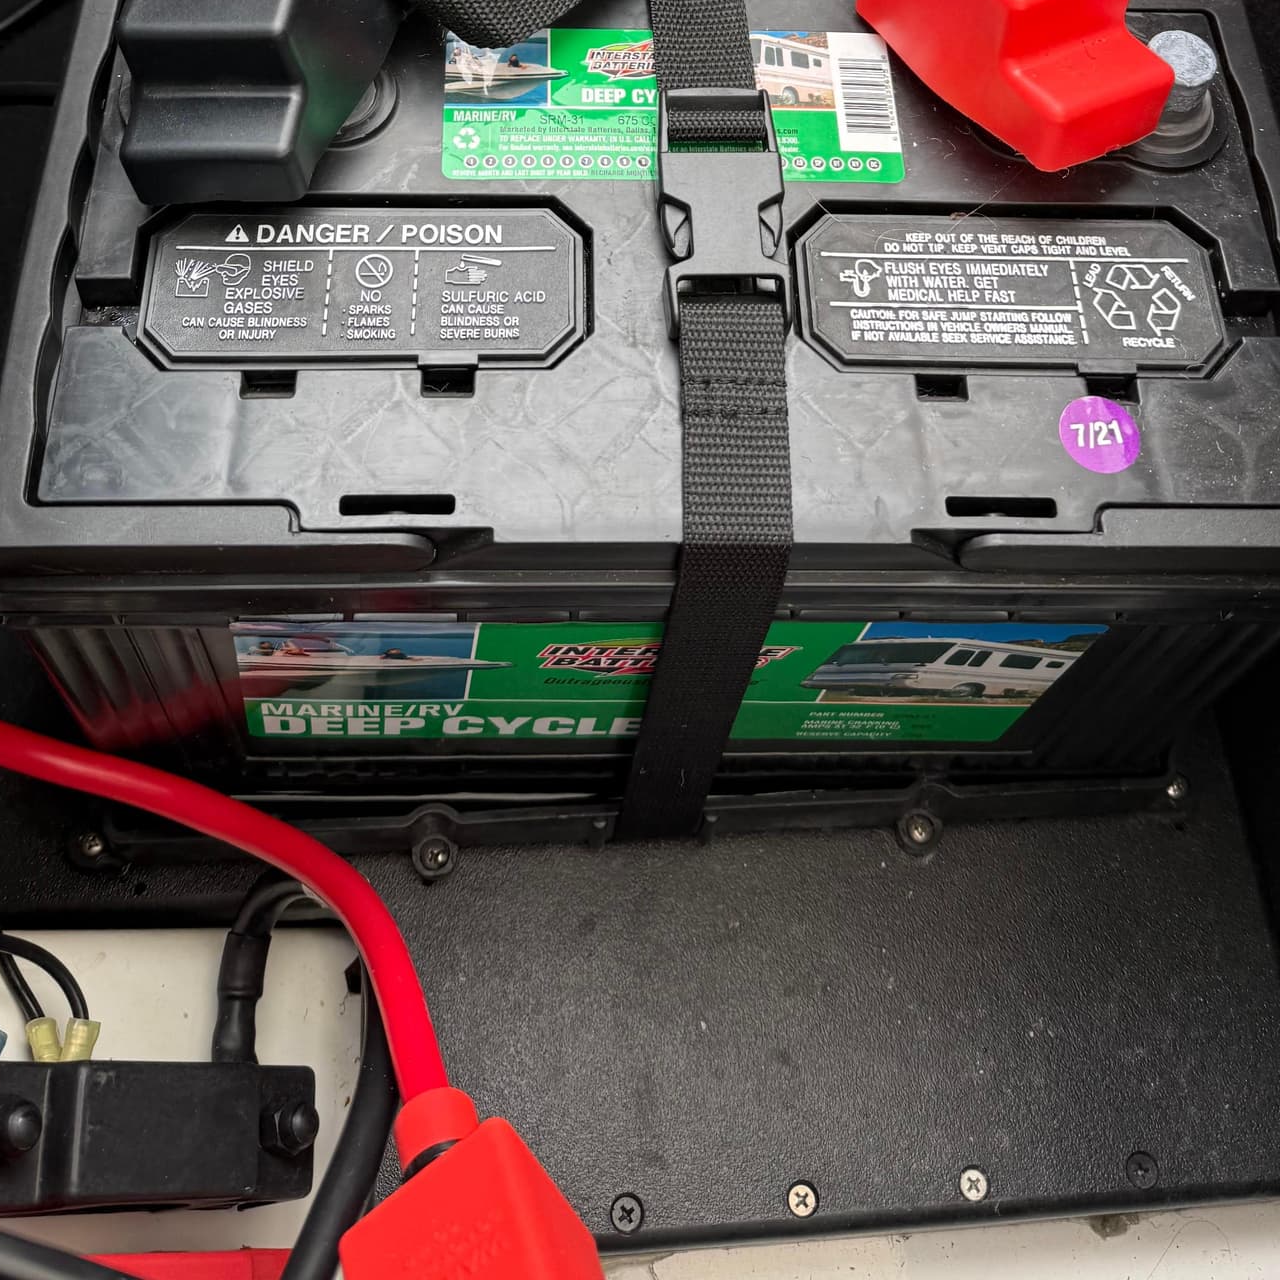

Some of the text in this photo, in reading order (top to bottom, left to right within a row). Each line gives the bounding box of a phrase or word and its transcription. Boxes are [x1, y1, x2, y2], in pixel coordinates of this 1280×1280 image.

[591, 52, 655, 60] INTERSTA
[582, 88, 626, 103] DEEP
[453, 111, 638, 125] MARINE/RV SRM-31 675
[255, 224, 370, 244] DANGER
[401, 224, 503, 244] POISON
[906, 233, 1106, 245] KEEP OUT OF THE REACH OF CHILDREN
[885, 243, 899, 252] DO
[902, 243, 925, 253] NOT
[951, 244, 978, 253] KEEP
[981, 244, 1007, 254] VENT
[1011, 245, 1039, 255] CAPS
[1042, 246, 1071, 256] TIGHT
[1075, 246, 1097, 255] AND
[1100, 247, 1131, 256] LEVEL
[263, 261, 314, 272] SHIELD
[884, 262, 1049, 277] FLUSH EYES IMMEDIATELY
[262, 274, 299, 286] EYES
[1083, 263, 1102, 288] LEAD
[886, 276, 999, 289] WITH WATER. GET
[1160, 265, 1196, 302] RETURN
[225, 287, 305, 300] EXPLOSIVE
[360, 291, 382, 302] NO
[441, 291, 546, 302] SULFURIC ACID
[888, 289, 1016, 302] MEDICAL HELP FAST
[223, 302, 273, 314] GASES
[349, 305, 392, 315] SPARKS
[441, 304, 504, 314] CAN CAUSE
[347, 317, 390, 327] FLAMES
[440, 317, 519, 326] BLINDNESS OR
[850, 309, 1072, 323] CAUTION: FOR SAFE JUMP STARTING FOLLOW
[182, 318, 307, 327] CAN CAUSE BLINDNESS
[853, 320, 924, 331] INSTRUCTIONS
[927, 322, 938, 331] IN
[940, 322, 980, 332] VEHICLE
[983, 323, 1026, 333] OWNERS
[219, 330, 277, 339] OR INJURY
[346, 329, 396, 339] SMOKING
[440, 328, 520, 339] SEVERE BURNS
[851, 331, 861, 341] IF
[864, 331, 885, 341] NOT
[888, 332, 939, 342] AVAILABLE
[942, 332, 968, 343] SEEK
[970, 333, 1011, 344] SERVICE
[1123, 337, 1176, 348] RECYCLE
[1068, 419, 1125, 450] 7/21
[260, 702, 465, 717] MARINE/RV
[262, 716, 641, 736] DEEP CYCLE
